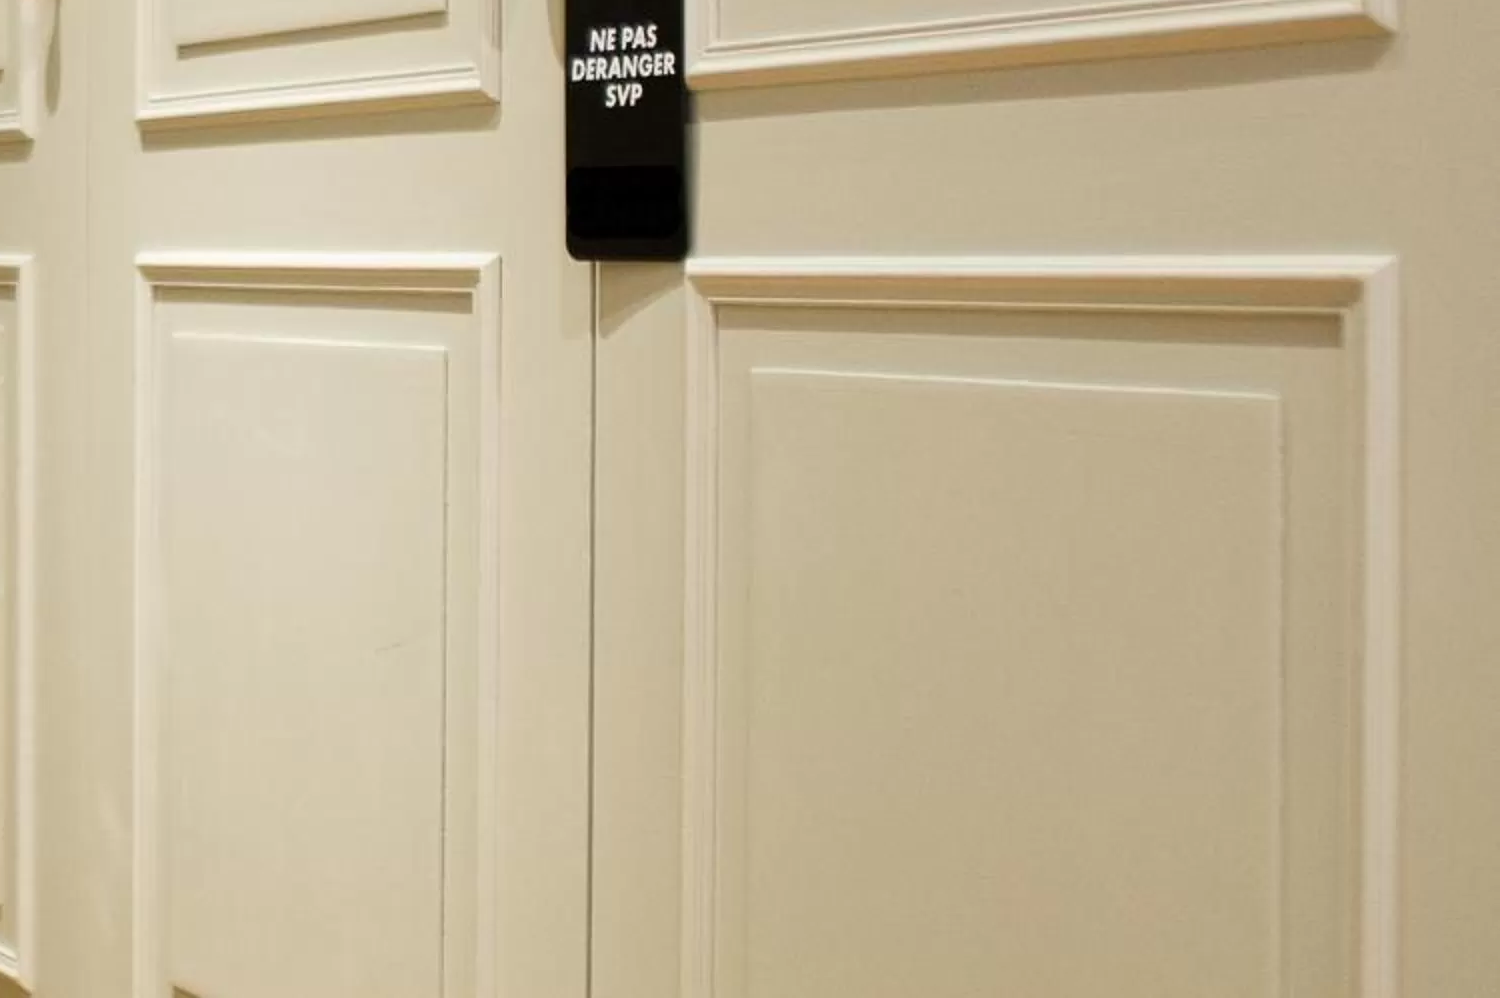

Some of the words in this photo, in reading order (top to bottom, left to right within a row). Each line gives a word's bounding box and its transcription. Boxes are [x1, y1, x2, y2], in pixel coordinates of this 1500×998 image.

[590, 27, 617, 52] NE
[621, 24, 657, 50] PAS
[571, 52, 676, 82] DERANGER
[605, 83, 643, 108] SVP
